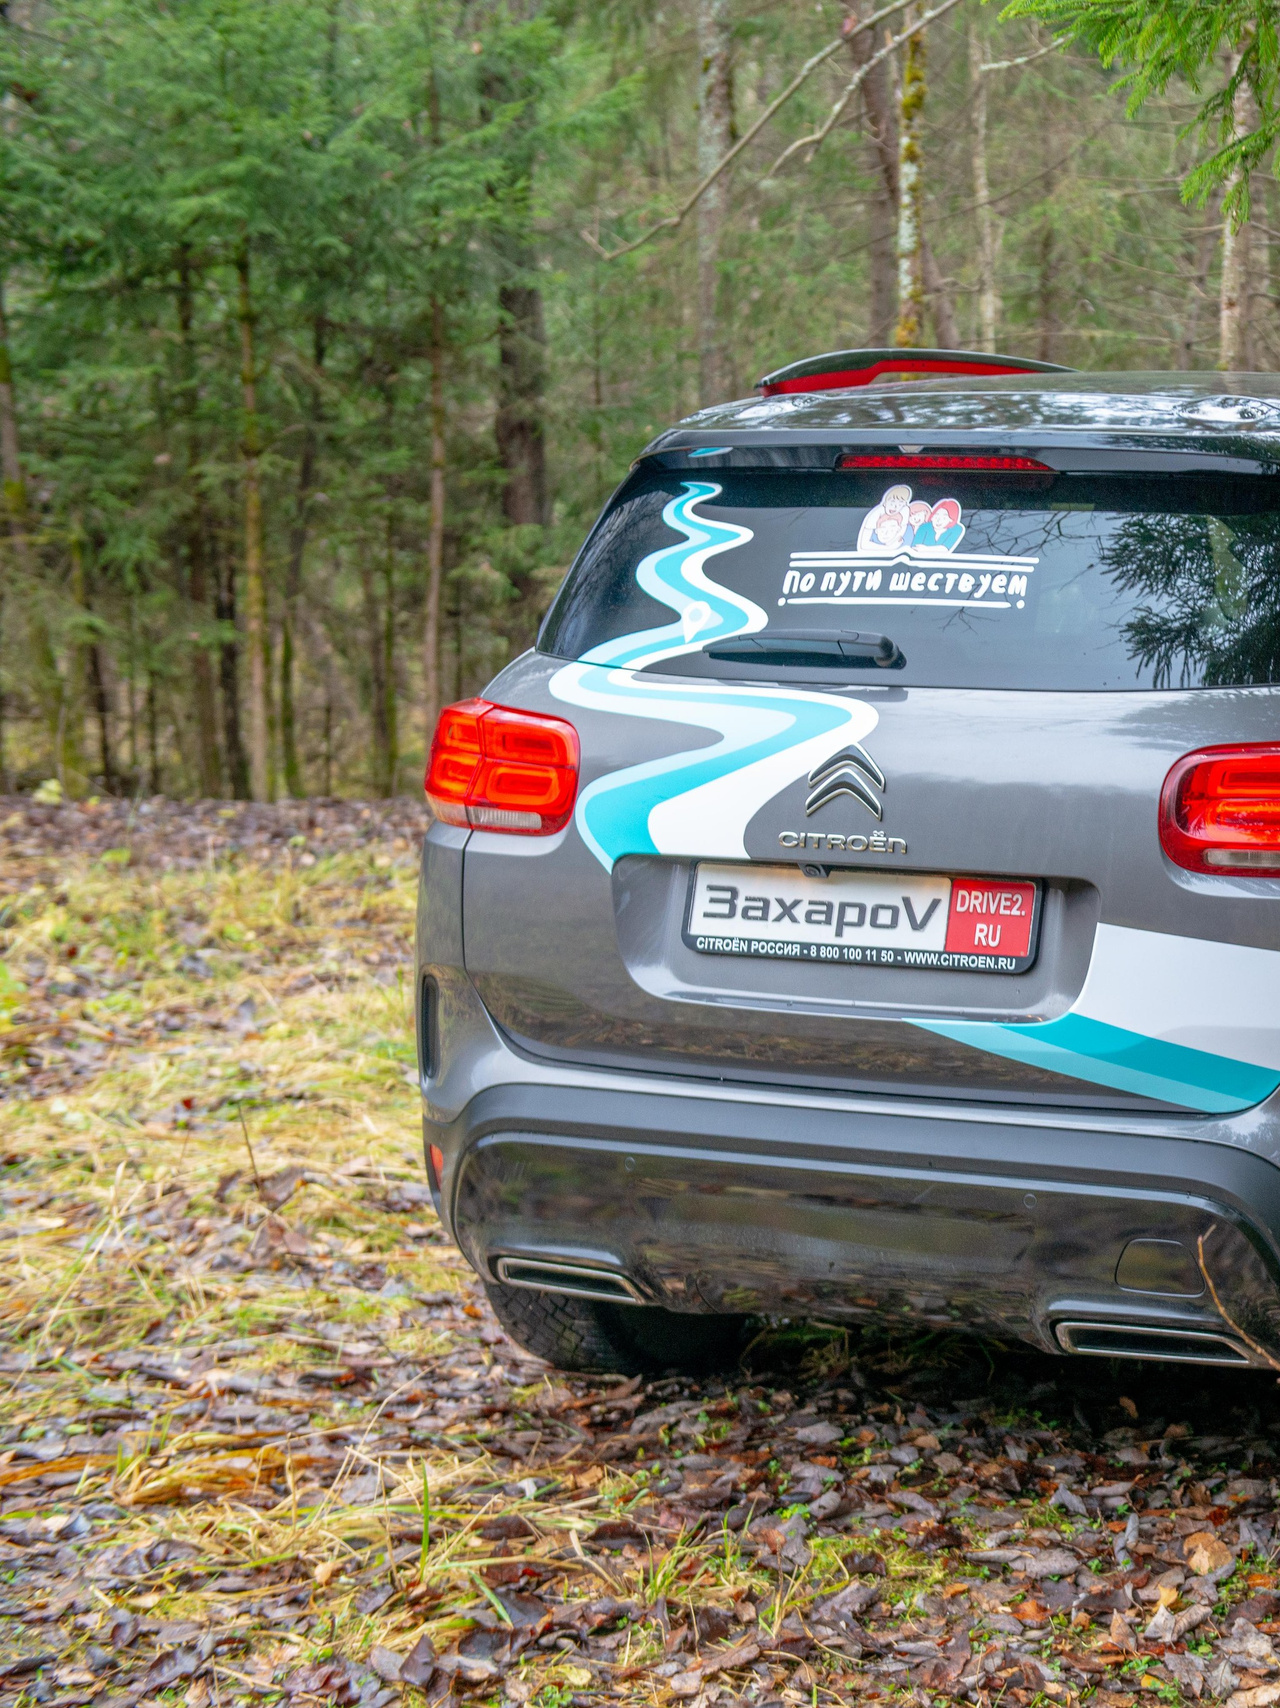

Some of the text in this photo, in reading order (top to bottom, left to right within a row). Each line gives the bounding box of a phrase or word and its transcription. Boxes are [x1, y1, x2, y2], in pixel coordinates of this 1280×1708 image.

[956, 889, 1026, 917] DRIVE2.
[974, 923, 1001, 948] RU
[695, 937, 748, 953] CITROËN
[750, 940, 801, 957] РОССИЯ
[810, 945, 817, 958] 8
[819, 945, 840, 960] 800
[842, 947, 862, 961] 100
[865, 949, 877, 962] 11
[880, 950, 894, 963] 50
[903, 951, 1016, 971] WWW.CITROEN.RU
